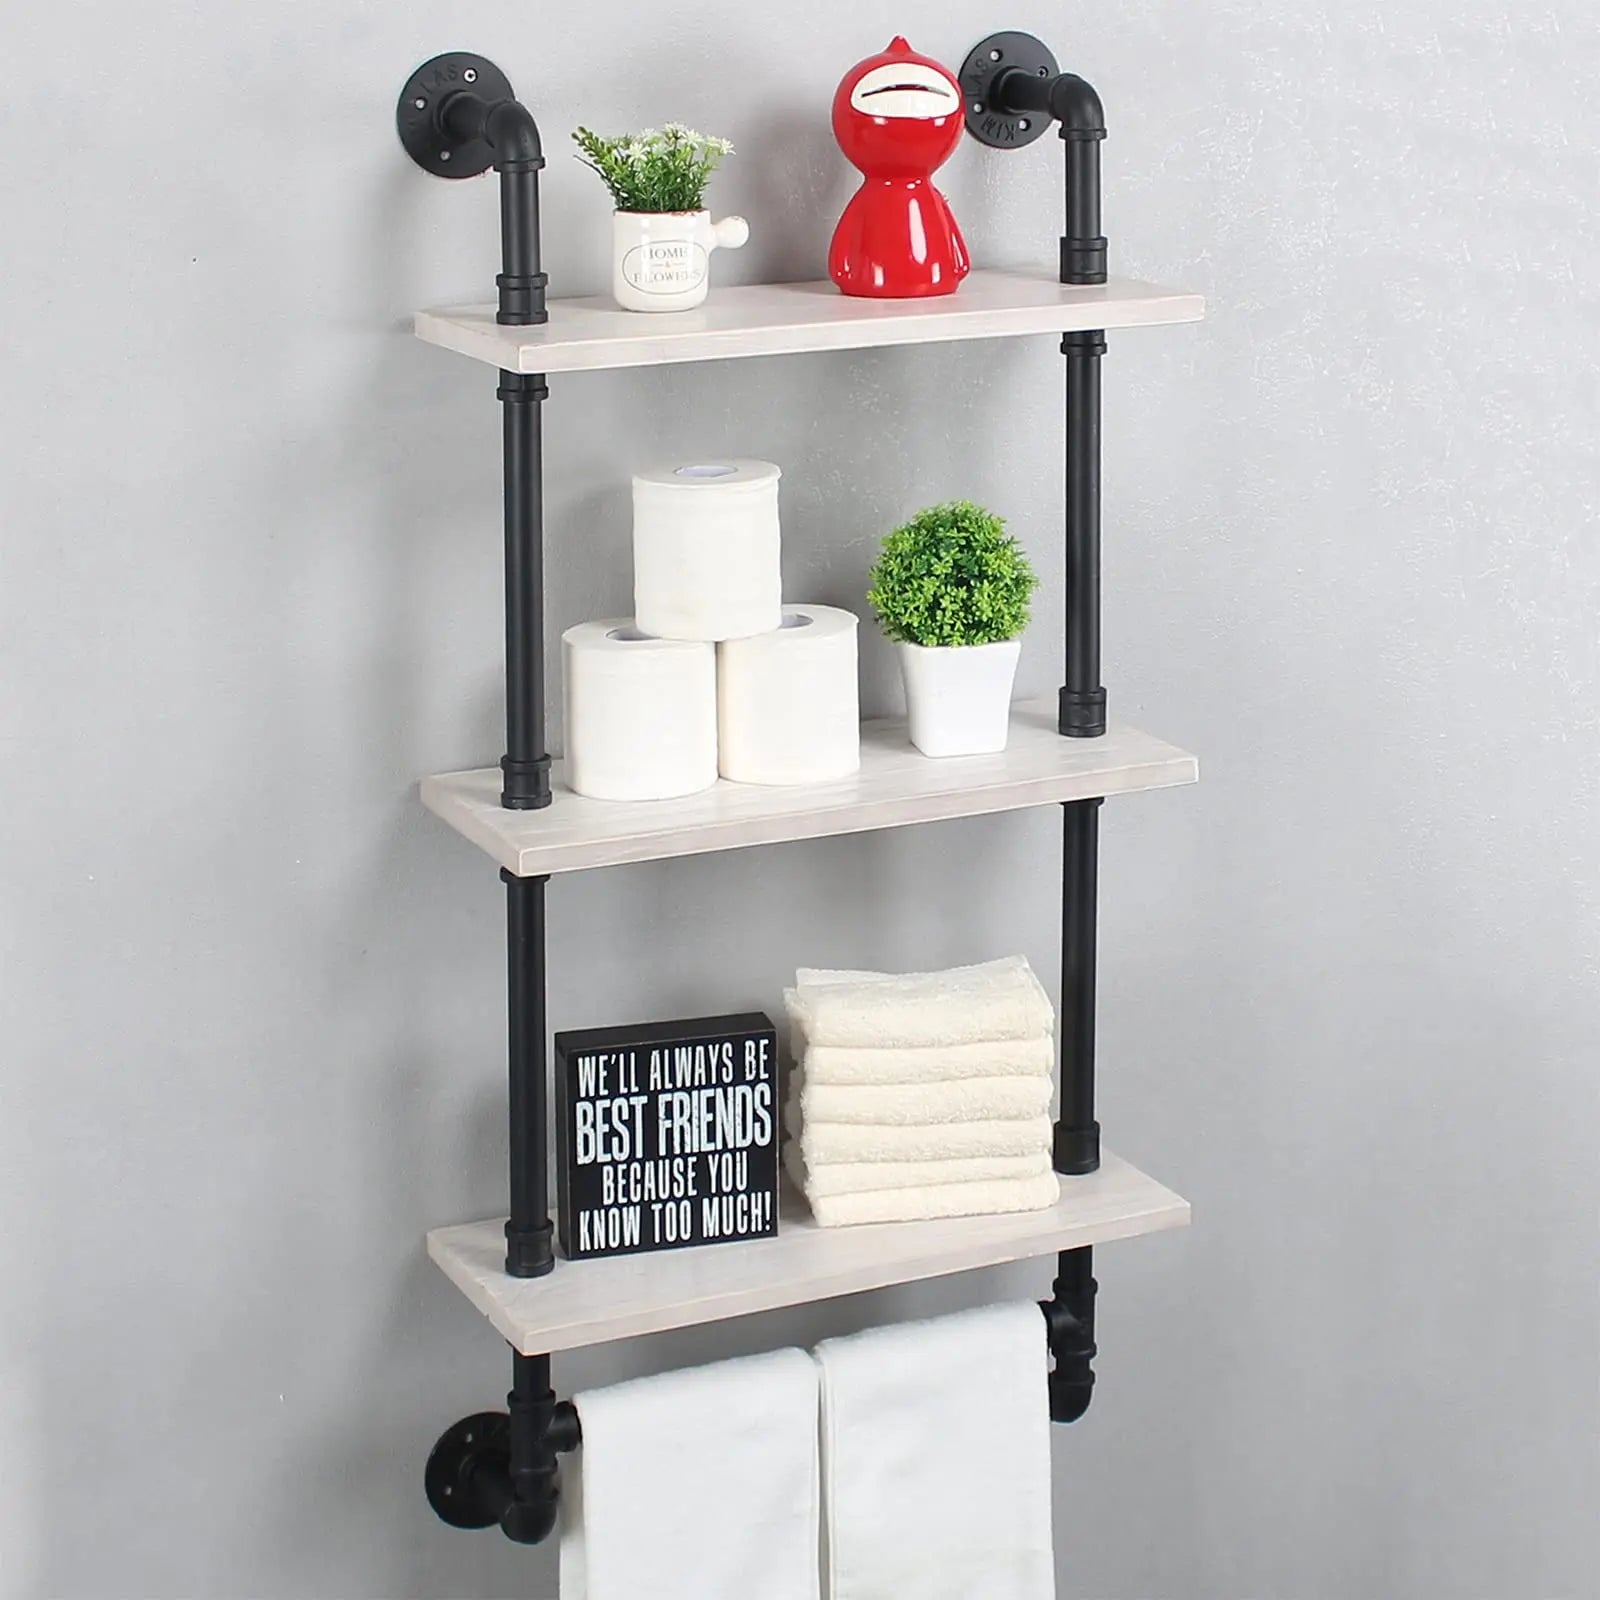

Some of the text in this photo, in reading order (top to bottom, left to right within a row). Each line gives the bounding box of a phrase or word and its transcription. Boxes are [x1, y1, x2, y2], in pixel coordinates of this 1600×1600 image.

[578, 1039, 769, 1098] WE'LL ALWAYS BE
[576, 1082, 772, 1165] BEST FRIENDS
[603, 1151, 748, 1206] BECAUSE YOU
[580, 1191, 771, 1252] KNOW TOO MUCH!
